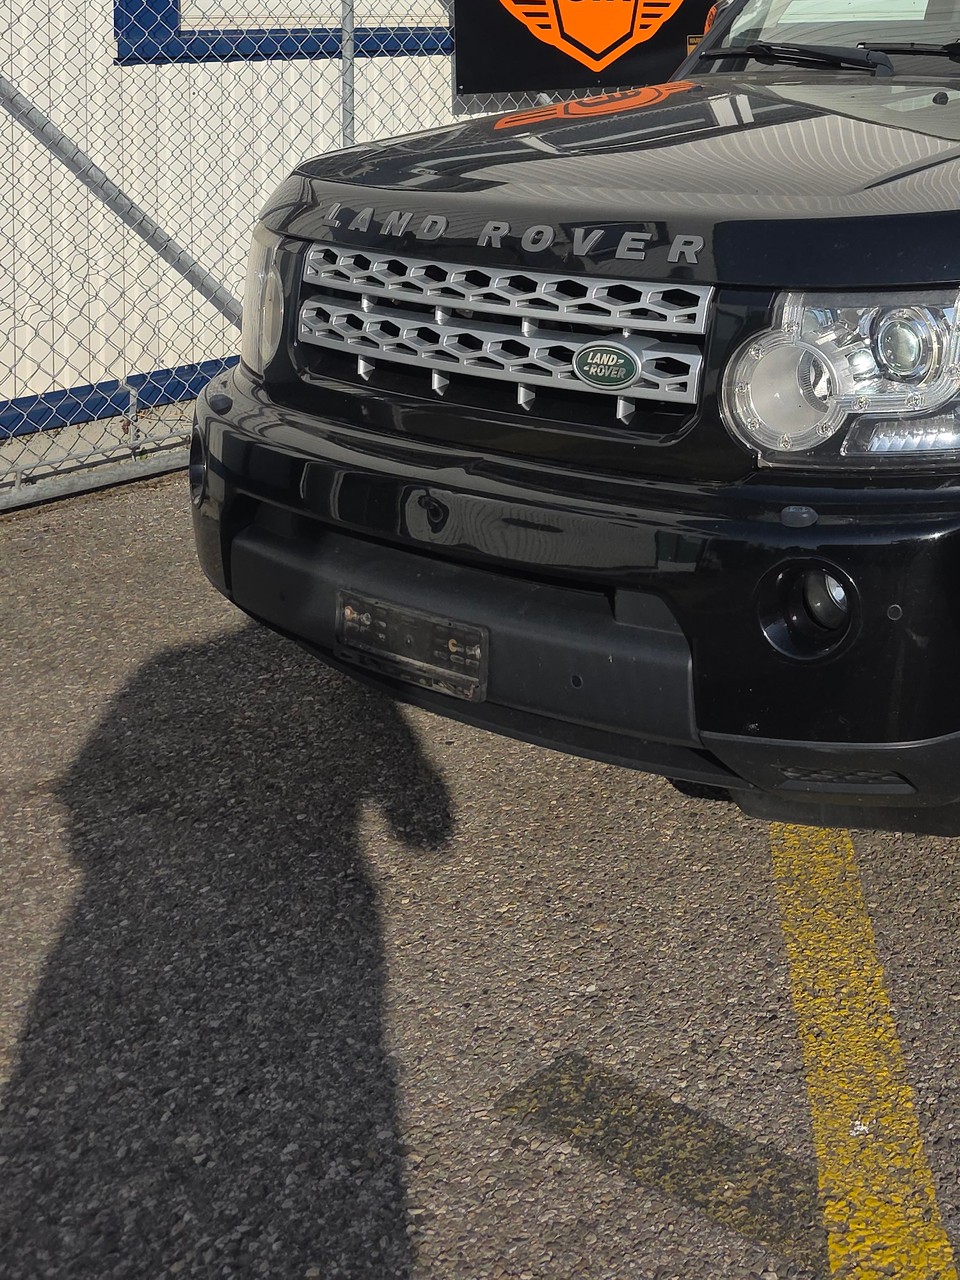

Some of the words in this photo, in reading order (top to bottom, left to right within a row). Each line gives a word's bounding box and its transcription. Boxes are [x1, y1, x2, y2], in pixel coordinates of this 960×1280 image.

[323, 202, 449, 241] LAND
[476, 220, 705, 265] ROVER
[587, 351, 618, 366] LAND
[588, 364, 627, 379] ROVER
